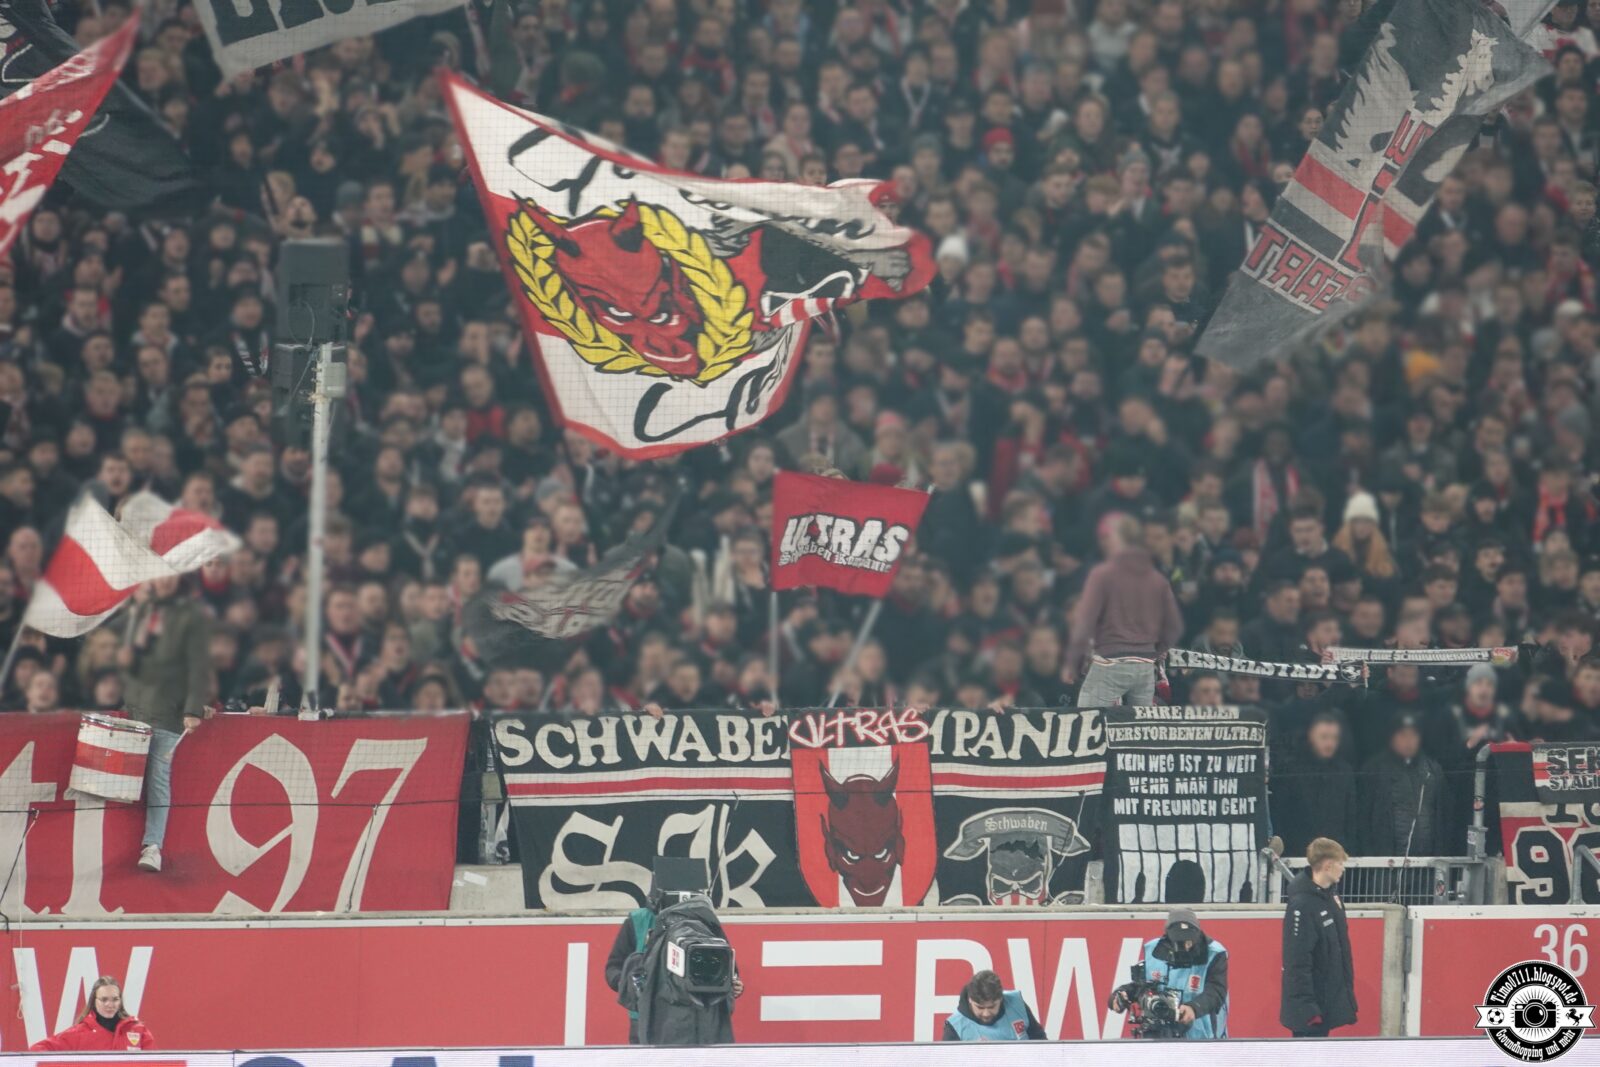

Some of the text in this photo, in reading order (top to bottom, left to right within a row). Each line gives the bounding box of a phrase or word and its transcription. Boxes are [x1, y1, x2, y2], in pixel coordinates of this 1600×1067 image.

[780, 513, 909, 562] ULTRAS
[1168, 648, 1339, 680] KESSELSTADT
[1133, 705, 1240, 720] EHRE ALLEN
[789, 707, 930, 748] ULTRAS
[1108, 726, 1263, 743] VERSTORBENEN ULTRAS
[495, 714, 791, 769] SCHWABE
[1117, 753, 1257, 773] KEIN WEG IST ZU WEIT
[1129, 777, 1238, 795] WENN MAN IHN
[1114, 797, 1257, 817] MIT FREUNDEN GEHT
[206, 733, 428, 913] 97
[984, 815, 1048, 832] Schwaben
[1534, 923, 1589, 978] 36
